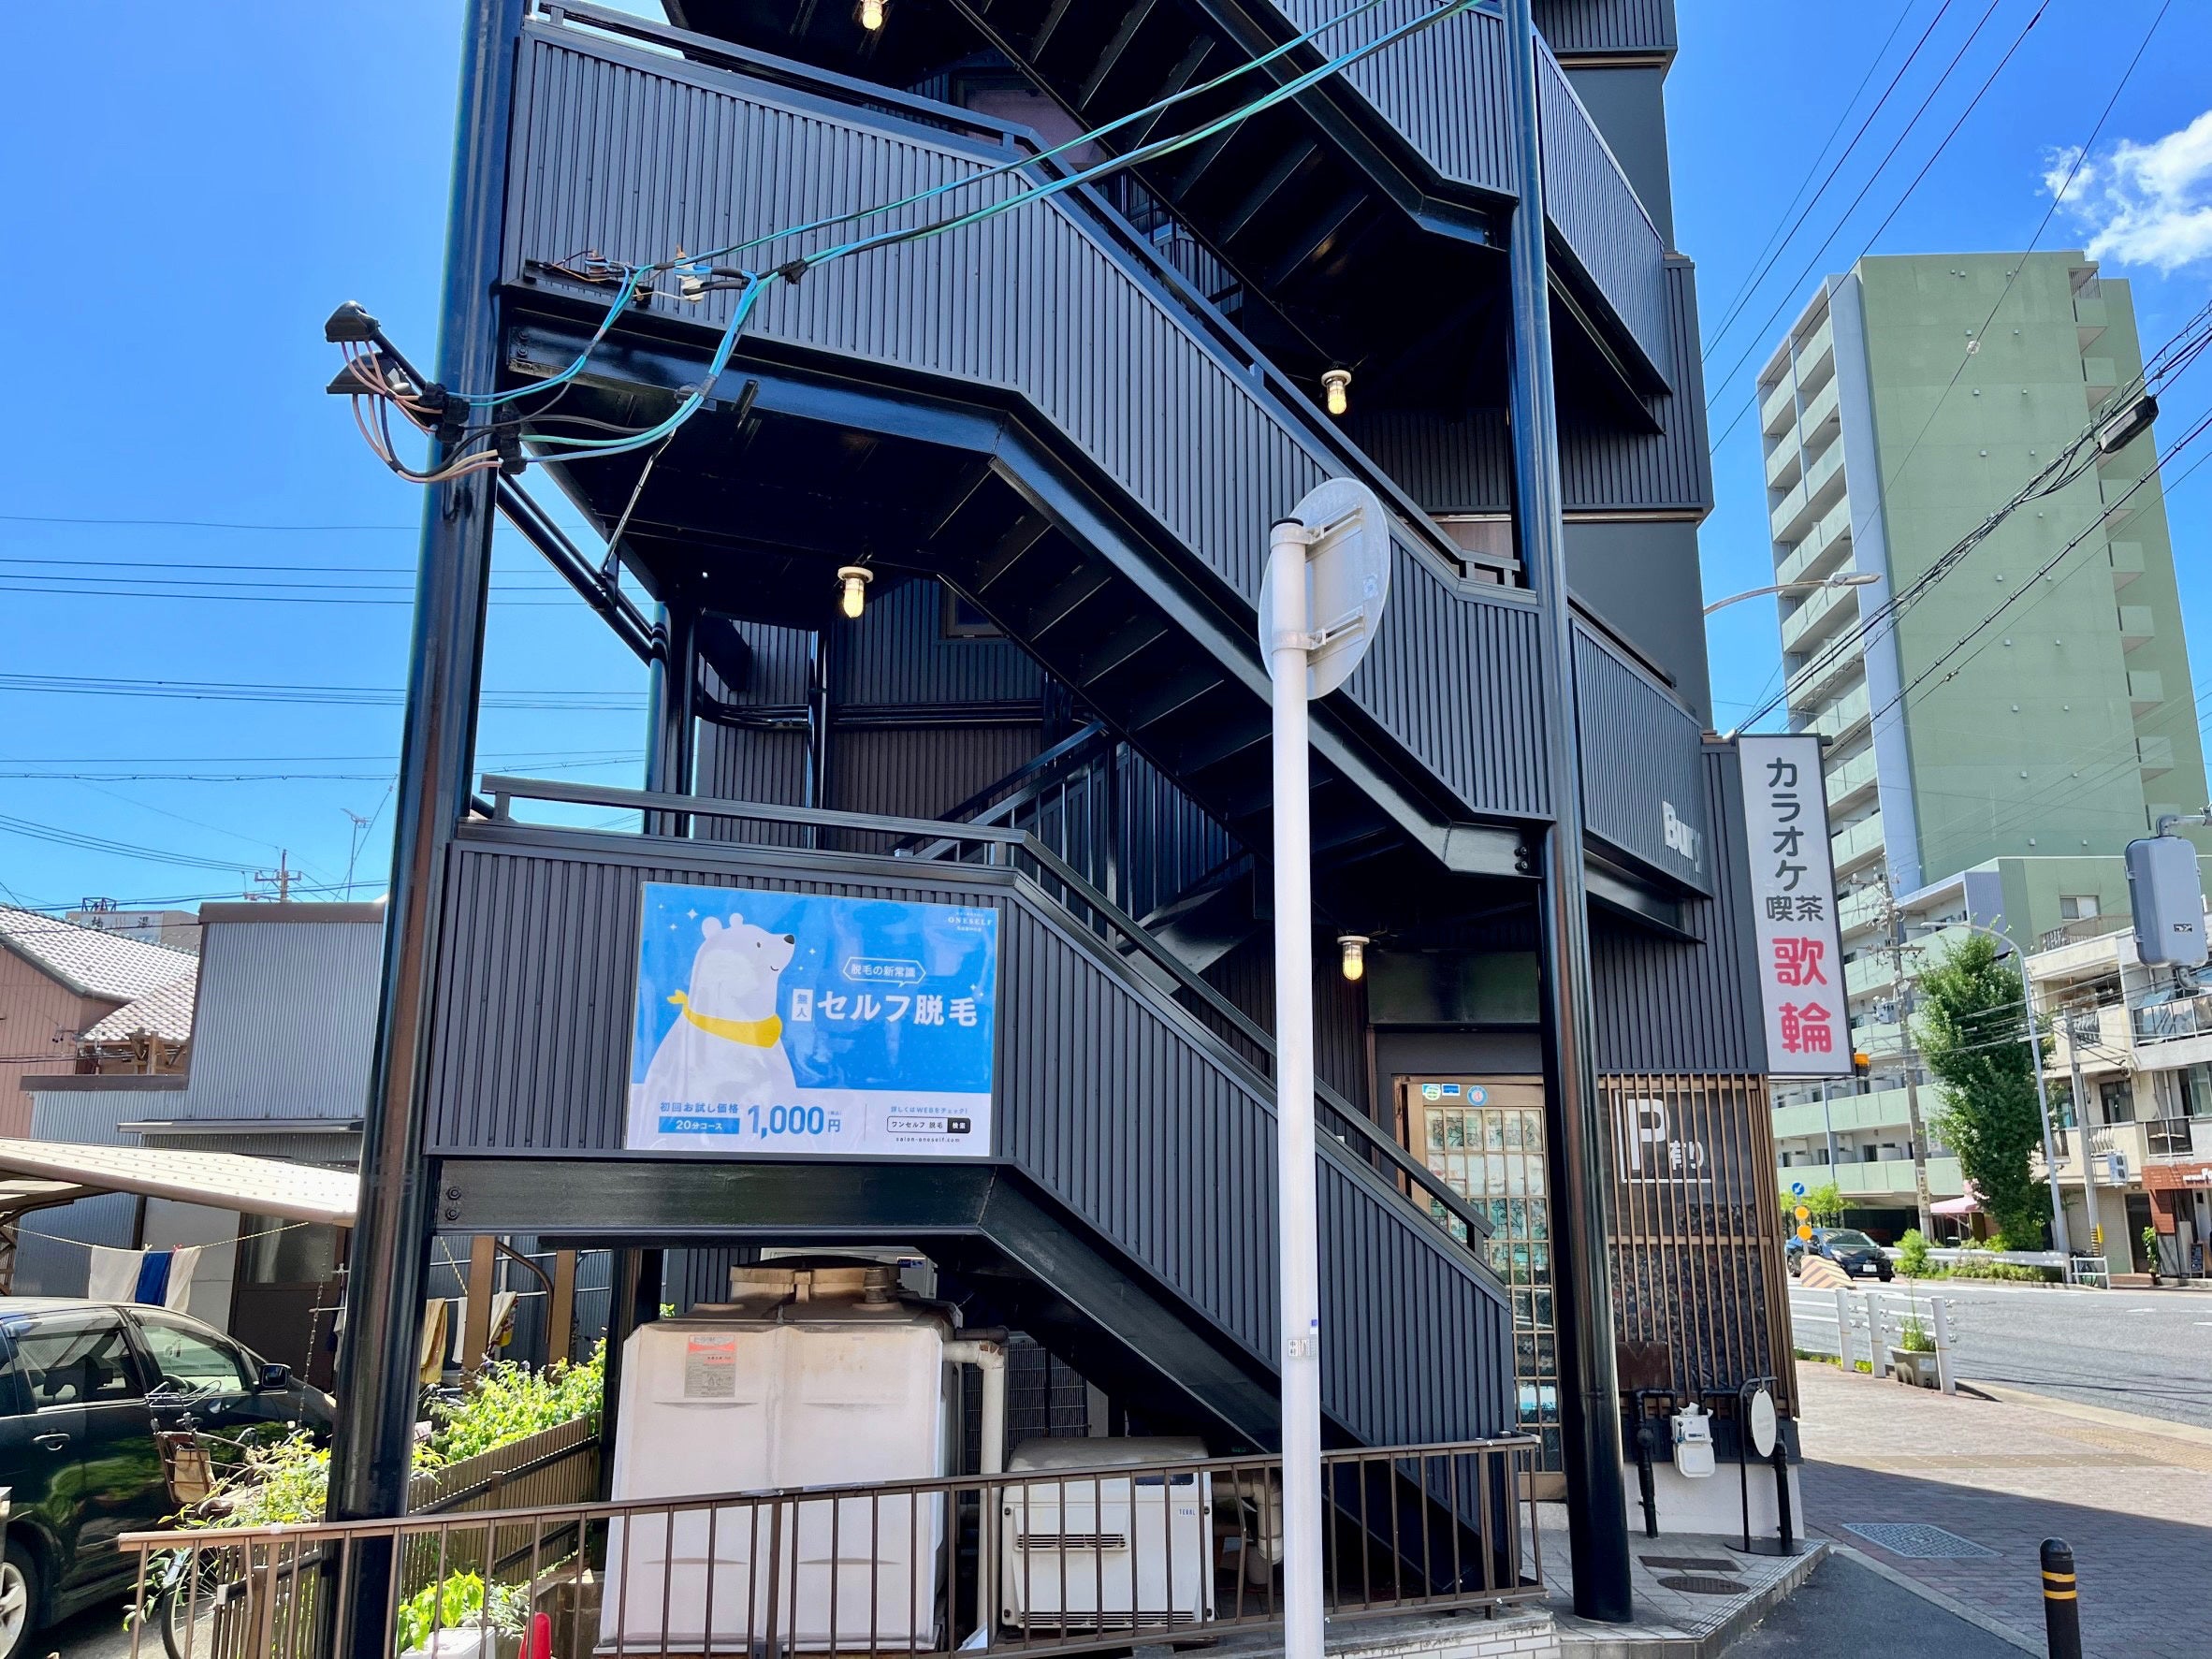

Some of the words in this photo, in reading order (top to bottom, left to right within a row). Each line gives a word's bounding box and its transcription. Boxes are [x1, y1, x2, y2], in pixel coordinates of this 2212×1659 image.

[1767, 757, 1808, 892] カラオケ
[1766, 895, 1825, 923] 喫茶
[948, 916, 992, 926] ONESELF
[851, 963, 916, 978] 脱毛の新常識
[795, 993, 808, 1018] 無人
[1771, 937, 1832, 1054] 歌輪
[817, 990, 979, 1026] セルフ脱毛
[660, 1101, 739, 1113] 初回お試し価格
[675, 1119, 723, 1131] 20分コース
[928, 1121, 943, 1129] 脱毛
